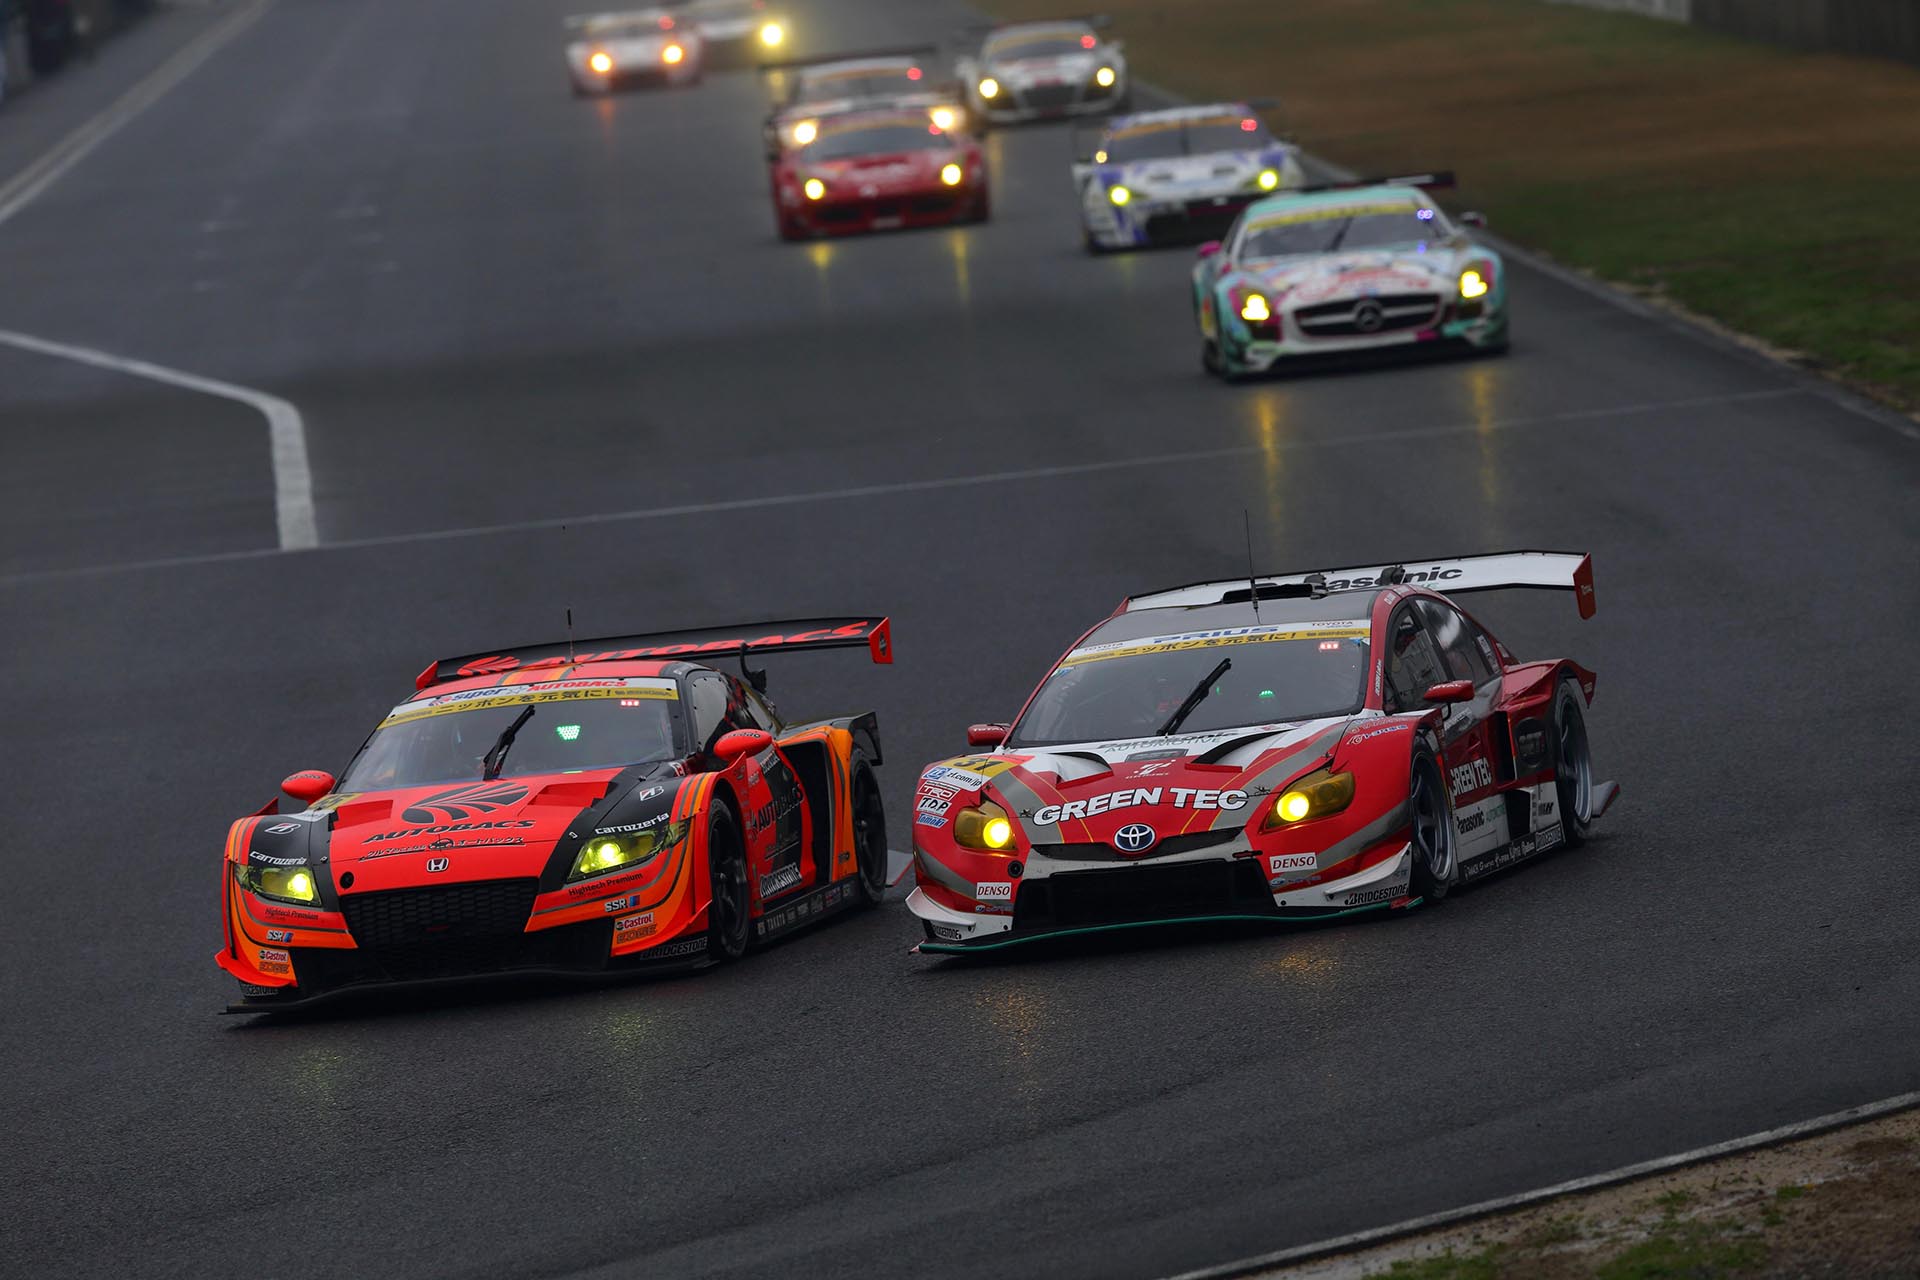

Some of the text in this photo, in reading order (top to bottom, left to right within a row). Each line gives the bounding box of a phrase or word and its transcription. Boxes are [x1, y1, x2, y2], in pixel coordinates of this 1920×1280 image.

[1153, 626, 1280, 644] PRIUS
[527, 681, 628, 692] AUTOBACS
[923, 785, 953, 798] TRD
[1033, 787, 1249, 826] GREEN TEC
[595, 813, 670, 834] carrozzeria
[361, 820, 536, 844] AUTOBACS
[249, 851, 307, 865] carrozzeria
[1272, 855, 1315, 870] DENSO
[568, 873, 643, 896] Hightech Premium
[977, 885, 1010, 896] DENSO
[1349, 883, 1410, 905] BRIDGESTONE
[604, 898, 627, 912] SSR
[264, 907, 290, 917] Hightech
[291, 911, 318, 920] Premium
[623, 914, 652, 929] Castrol
[267, 930, 284, 942] SSR
[265, 951, 288, 961] Castrol
